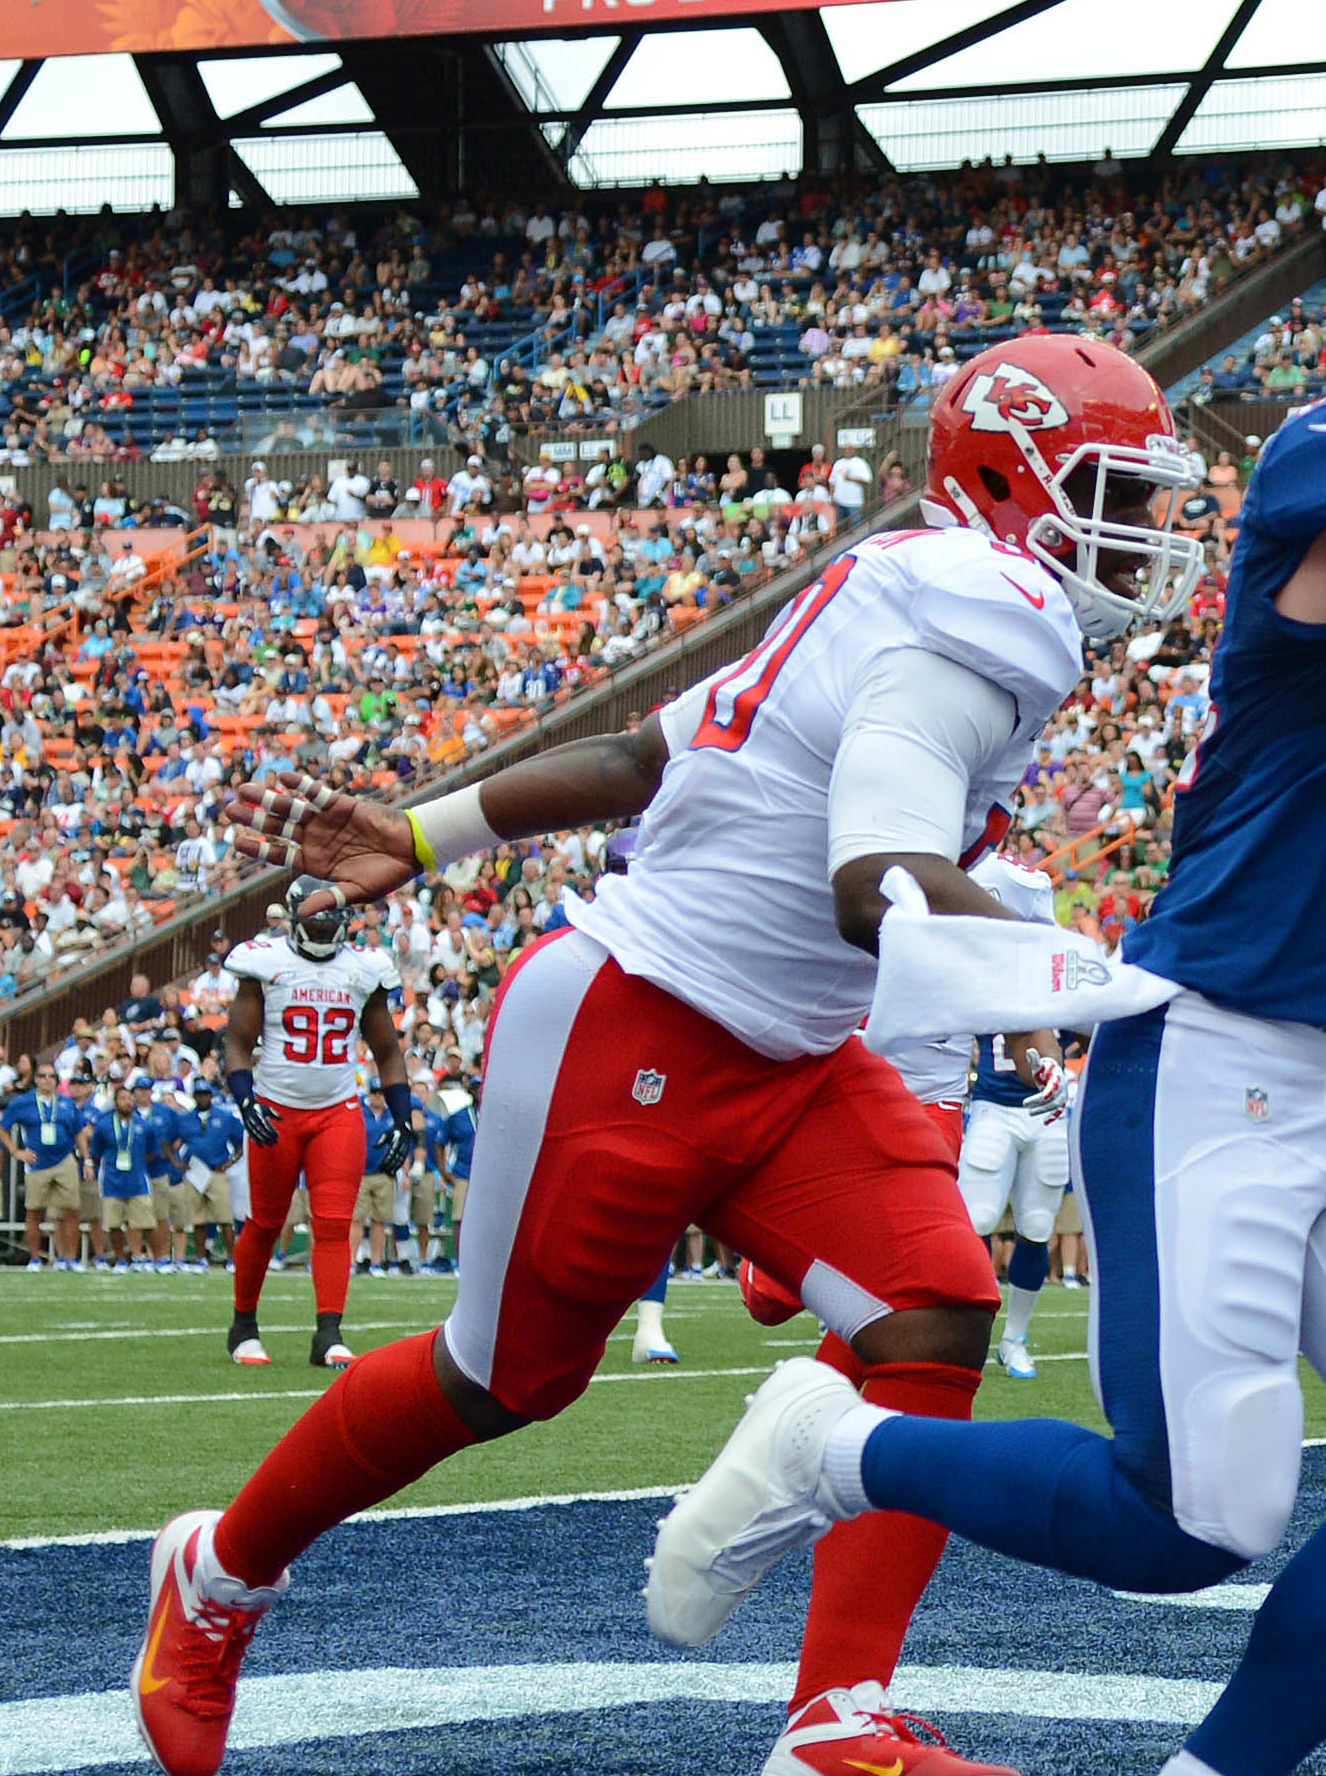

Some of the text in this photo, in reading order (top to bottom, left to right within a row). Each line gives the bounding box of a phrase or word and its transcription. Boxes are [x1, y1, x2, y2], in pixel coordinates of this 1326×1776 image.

[770, 402, 794, 421] LL
[983, 376, 1051, 426] KC
[292, 988, 351, 1003] AMERICAN
[282, 1005, 355, 1064] 92
